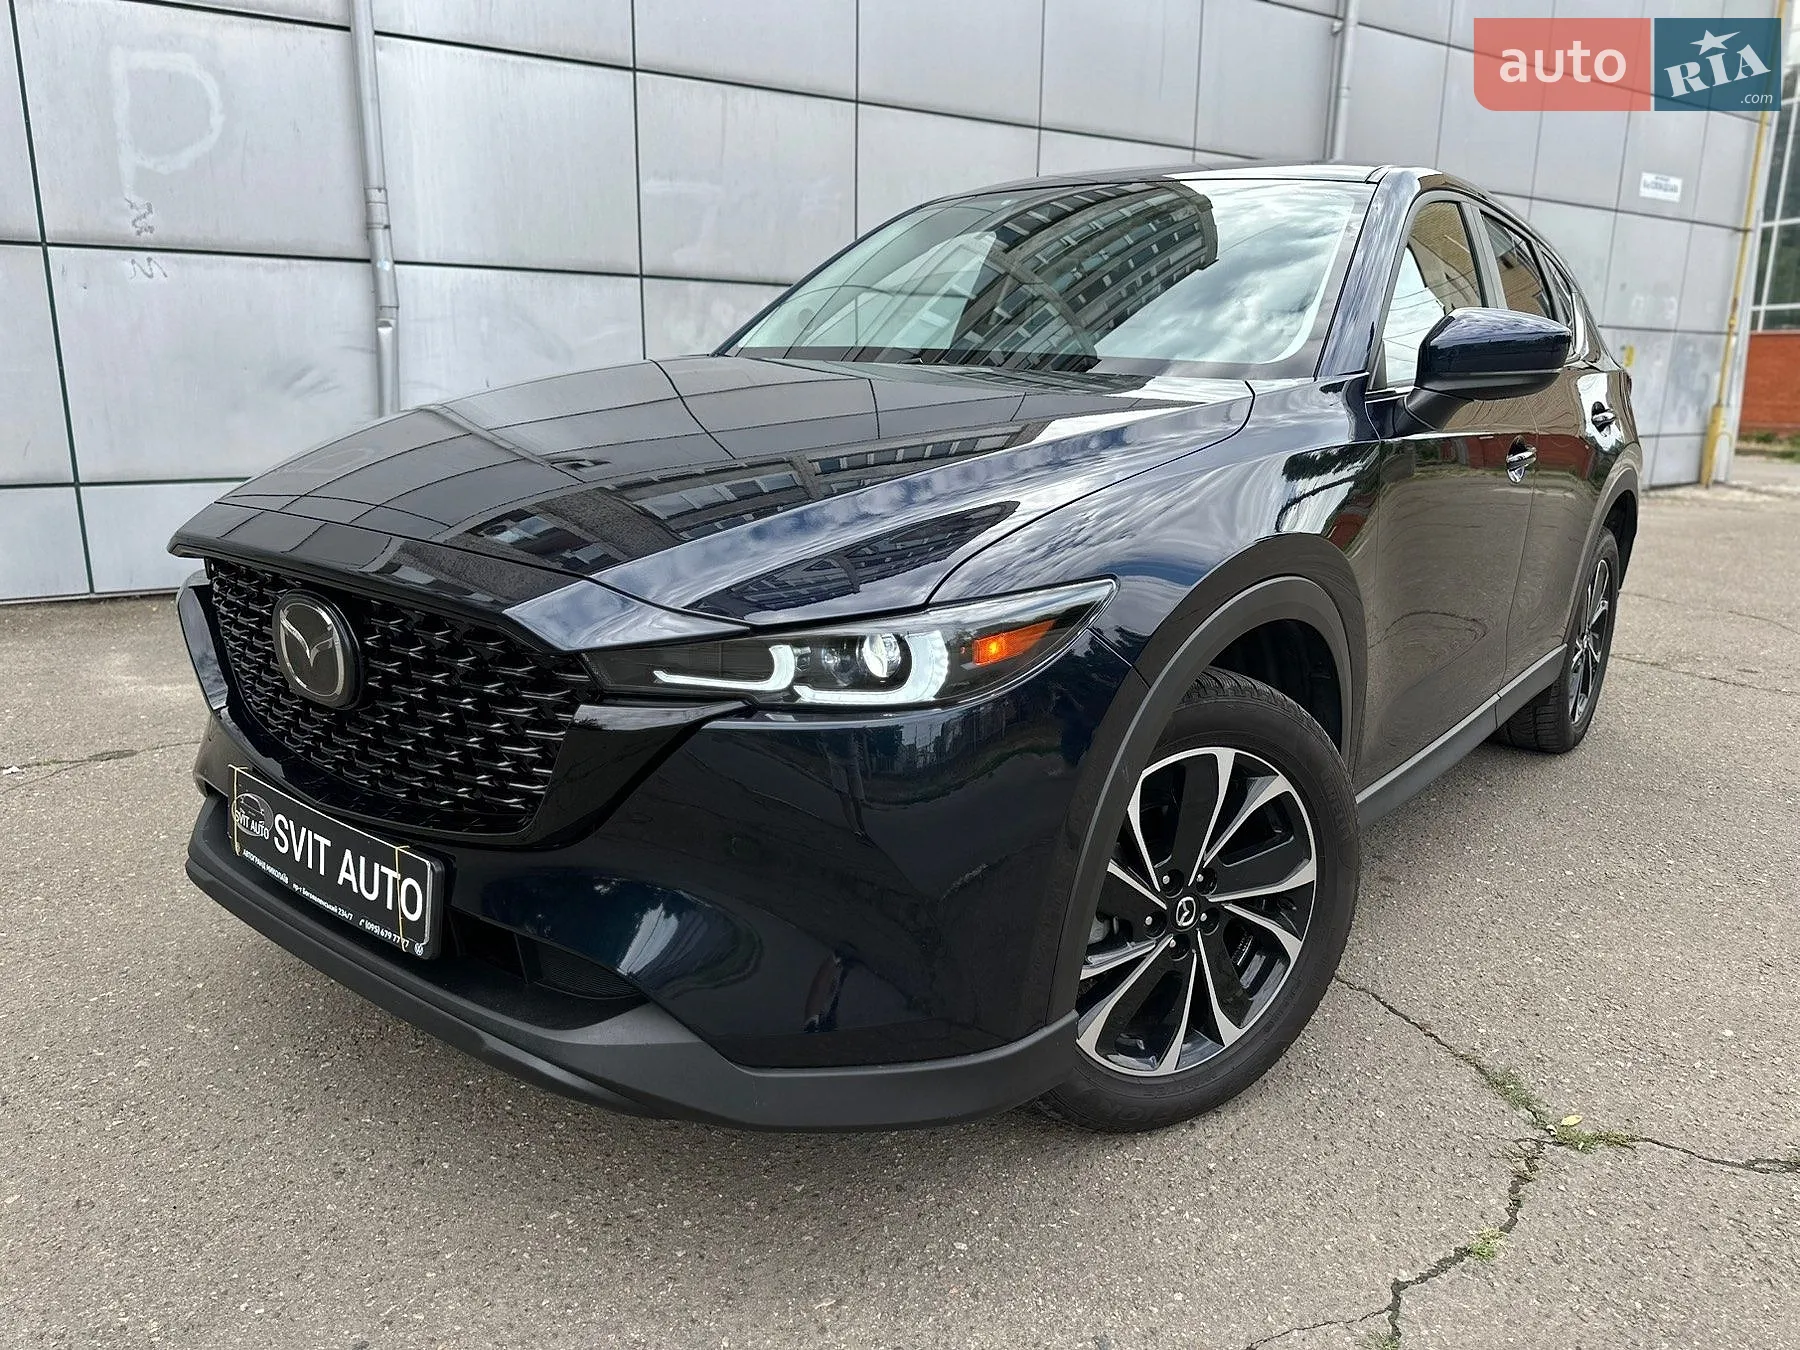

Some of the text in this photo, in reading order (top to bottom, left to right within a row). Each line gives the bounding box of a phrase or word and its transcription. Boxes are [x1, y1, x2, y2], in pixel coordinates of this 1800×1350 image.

[250, 819, 269, 840] AUTO
[273, 813, 424, 922] SVIT AUTO
